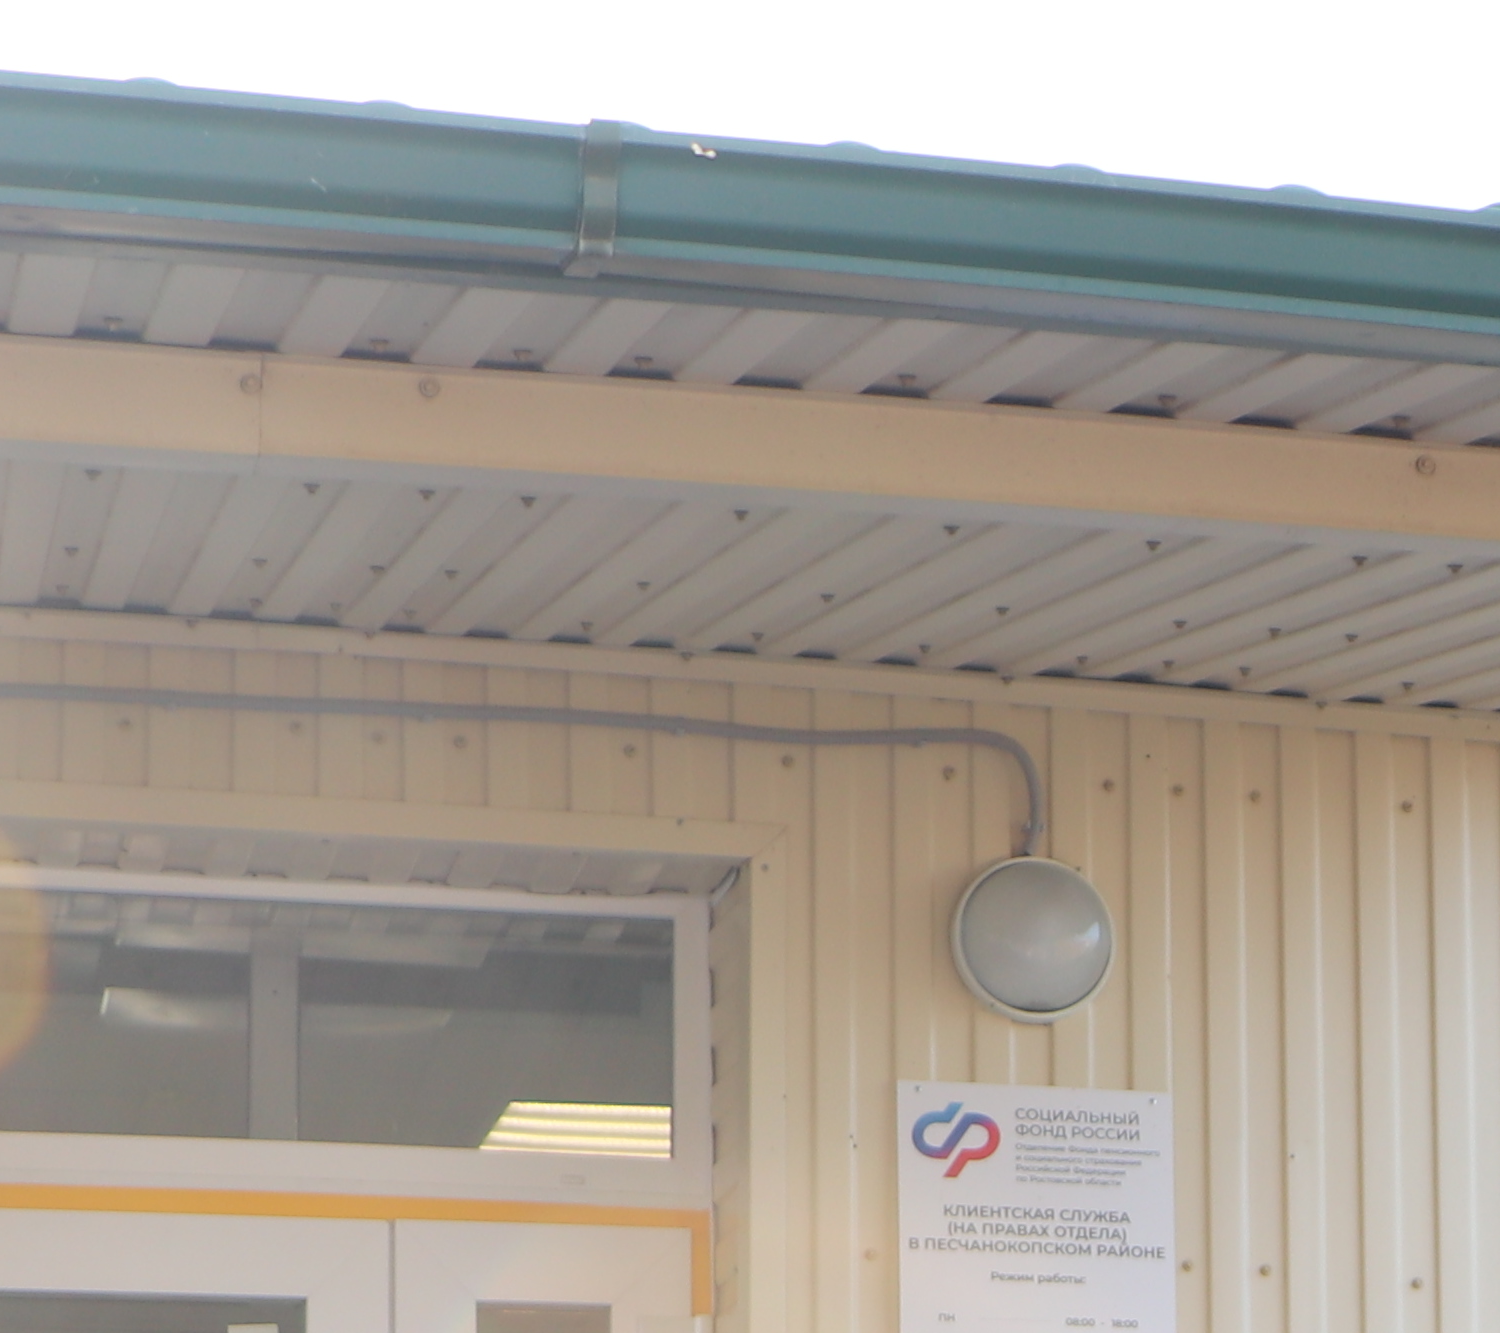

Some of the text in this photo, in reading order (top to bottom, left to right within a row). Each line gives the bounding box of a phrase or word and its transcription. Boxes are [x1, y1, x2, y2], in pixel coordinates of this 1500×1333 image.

[1015, 1108, 1140, 1126] СОЦИАЛЬНЫЙ
[1015, 1124, 1141, 1142] ФОНД РОССИИ
[943, 1204, 1131, 1224] КЛИЕНТСКАЯ СЛУЖБА
[948, 1222, 1128, 1245] (НА ПРАВАХ ОТДЕЛА)
[909, 1237, 1165, 1259] В ПЕСЧАНОКОПСКОМ РАЙОНЕ
[990, 1271, 1086, 1286] Режим работы:
[939, 1312, 956, 1323] ПН
[1065, 1317, 1096, 1327] 08:00
[1111, 1318, 1139, 1328] 18:00
